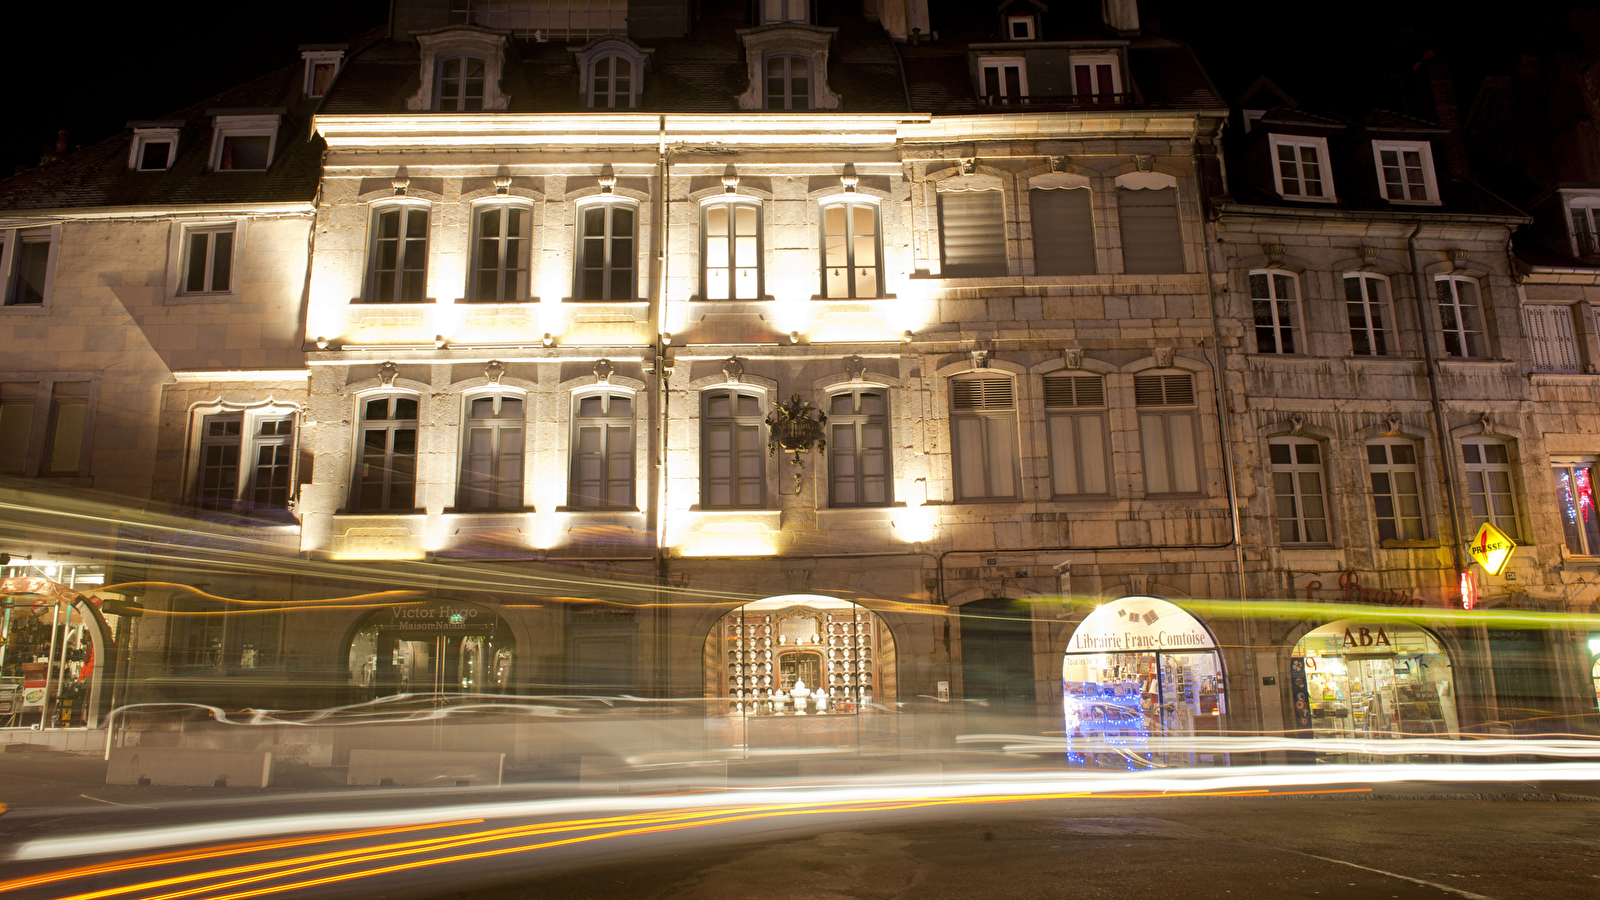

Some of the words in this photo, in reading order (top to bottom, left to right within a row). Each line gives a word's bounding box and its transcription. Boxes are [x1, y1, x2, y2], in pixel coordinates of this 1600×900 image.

[1472, 542, 1503, 555] PRESSE
[1461, 573, 1469, 609] TABAC
[391, 606, 436, 619] Victor
[439, 605, 478, 623] Hugo
[399, 621, 435, 630] Maison
[436, 620, 467, 630] Natale
[1076, 633, 1122, 649] Librairie
[1124, 629, 1206, 650] Franc-Comtoise
[1305, 656, 1317, 671] 9
